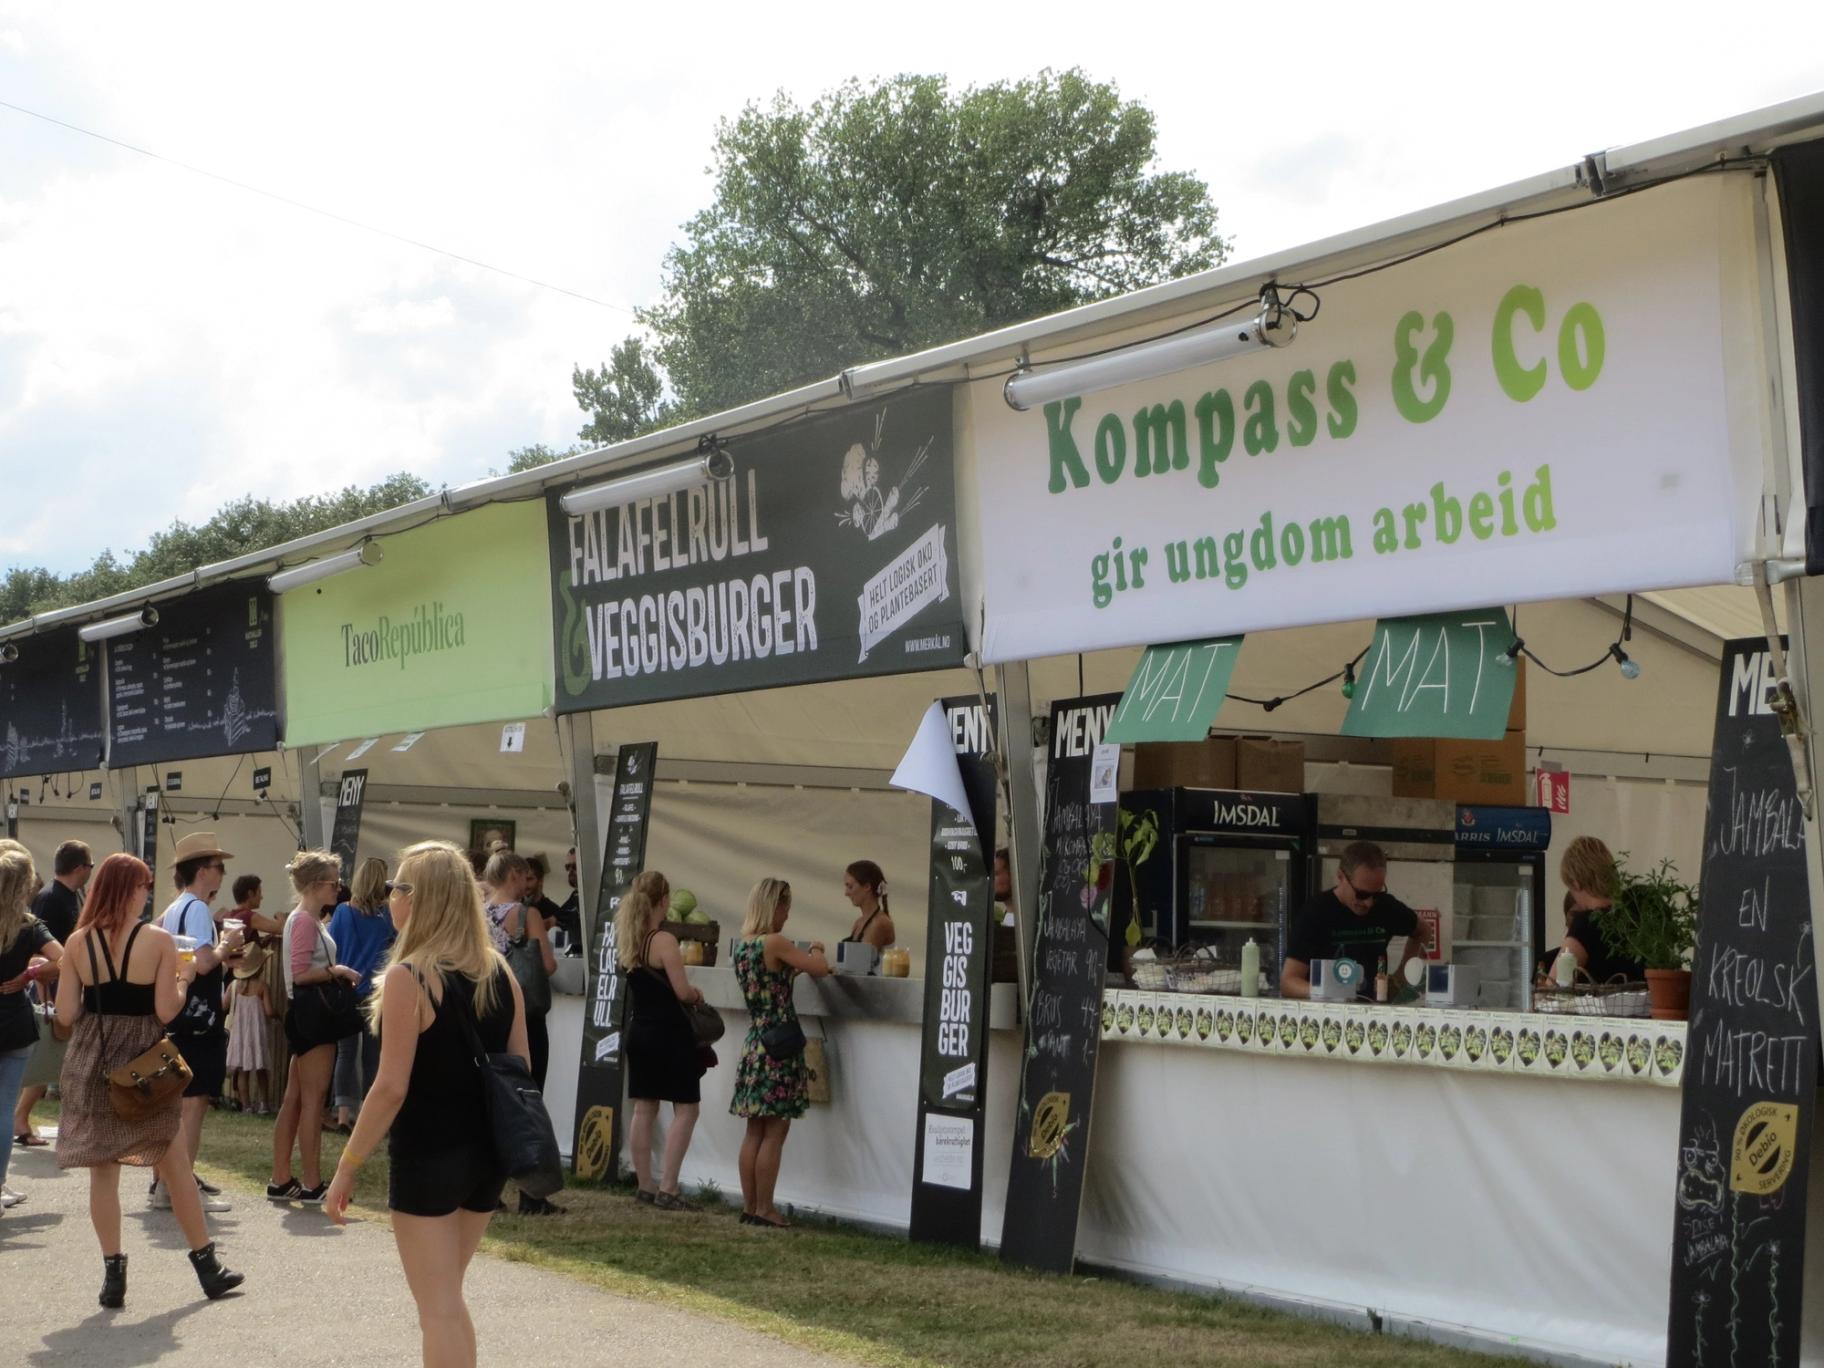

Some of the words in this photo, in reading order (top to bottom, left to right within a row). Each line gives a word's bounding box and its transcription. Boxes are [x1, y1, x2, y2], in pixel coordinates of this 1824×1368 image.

[1042, 359, 1359, 495] Kompass
[1391, 311, 1455, 424] &
[1491, 284, 1606, 402] Co
[568, 468, 769, 586] FALAFELRULL
[1090, 536, 1148, 609] gir
[1165, 509, 1353, 590] ungdom
[1373, 465, 1558, 553] arbeid
[868, 611, 879, 634] OG
[880, 563, 938, 625] PLANTEBASERT
[869, 578, 888, 608] HELT
[889, 556, 917, 593] LOGISK
[586, 565, 818, 681] VEGGISBURGER
[1119, 643, 1233, 723] MAT
[1362, 621, 1497, 715] MAT
[1728, 651, 1792, 717] ME
[338, 775, 365, 807] MENY
[1213, 800, 1281, 827] IMSDAL
[1496, 827, 1539, 844] IMSDAL
[1739, 875, 1770, 932] EN
[944, 922, 973, 955] VEG
[942, 955, 968, 988] GIS
[1708, 943, 1812, 1026] KREOLSK
[593, 1000, 612, 1028] ULL
[940, 988, 971, 1023] BUR
[1036, 990, 1062, 1029] BRUS
[938, 1023, 969, 1057] GER
[1702, 1018, 1808, 1097] MATRETT
[1749, 1132, 1777, 1167] Debio
